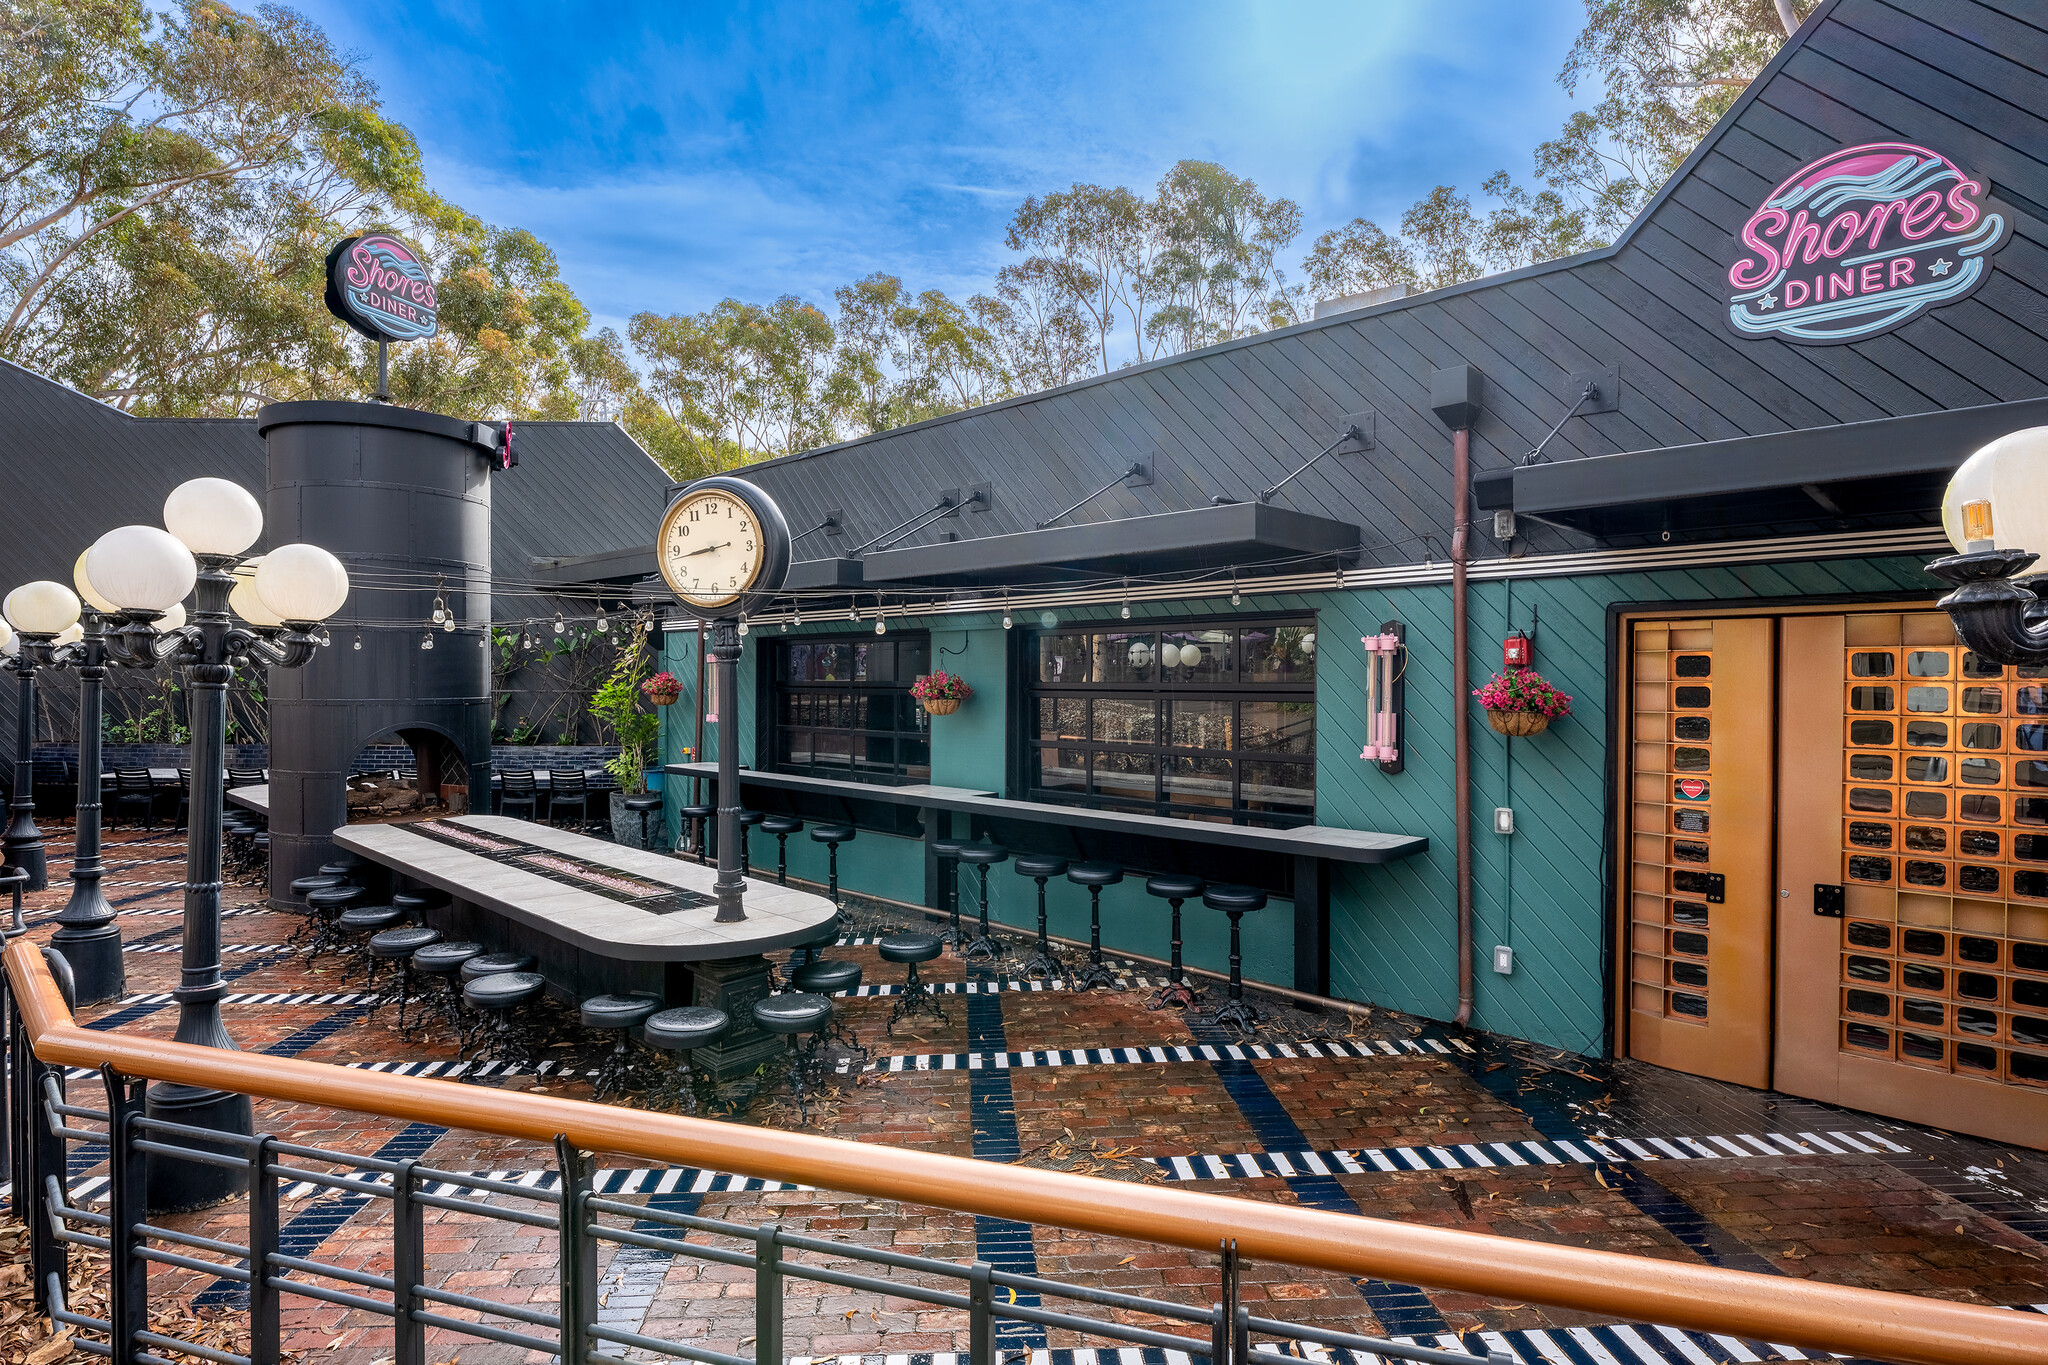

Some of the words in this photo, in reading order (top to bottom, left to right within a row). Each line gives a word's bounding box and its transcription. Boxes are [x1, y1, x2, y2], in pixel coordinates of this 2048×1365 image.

[1728, 180, 1981, 289] Shores
[347, 246, 435, 308] Shores
[1785, 257, 1915, 308] DINER
[370, 292, 416, 322] DINER
[705, 503, 718, 514] 12
[727, 507, 733, 518] 1
[689, 510, 700, 521] 11
[678, 525, 689, 537] 10
[740, 521, 747, 532] 2
[673, 545, 680, 556] 9
[746, 540, 753, 552] 3
[680, 565, 688, 577] 8
[740, 562, 748, 573] 4
[692, 578, 699, 589] 7
[729, 576, 737, 587] 5
[711, 583, 719, 594] 6
